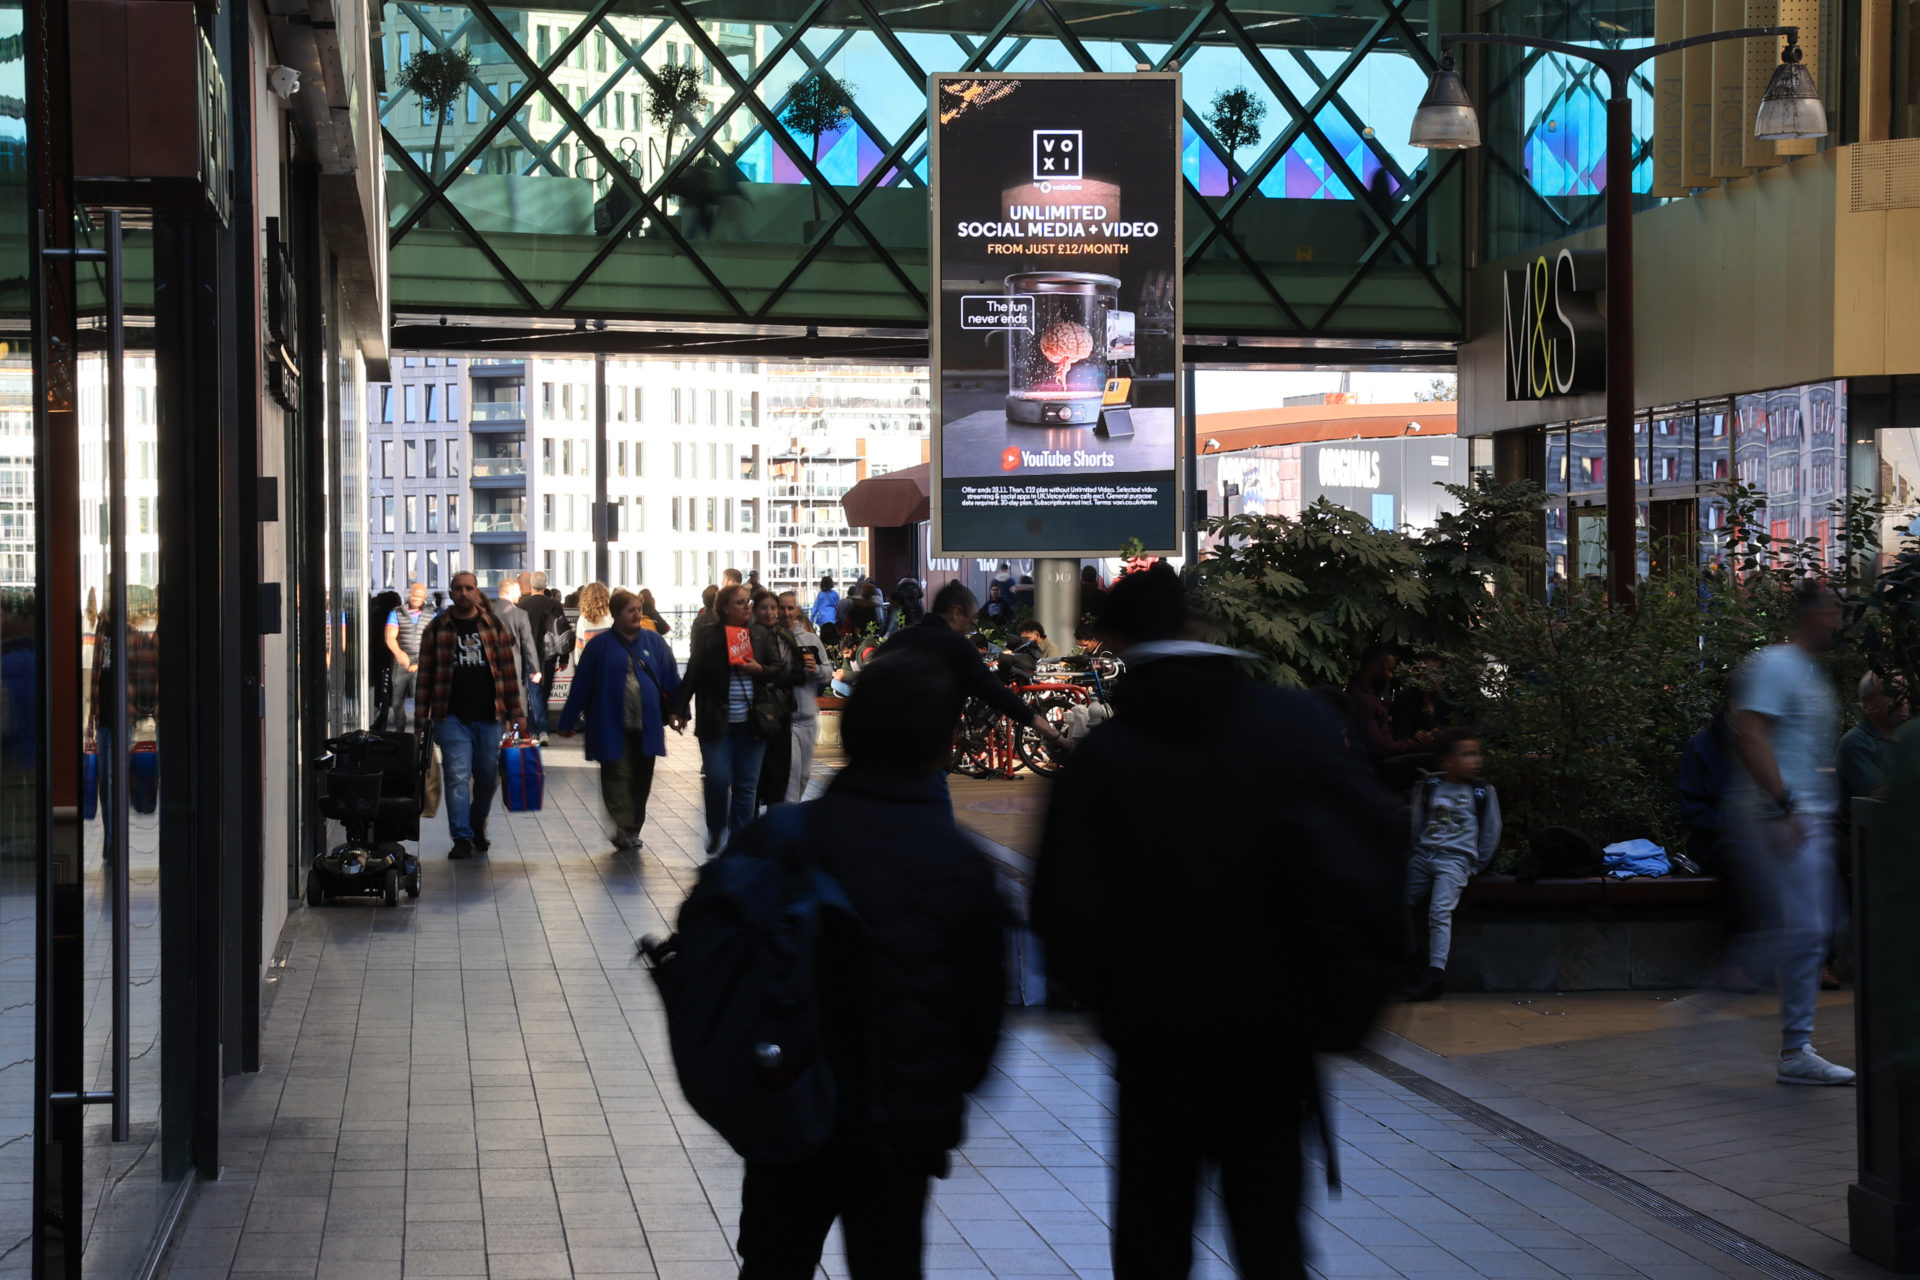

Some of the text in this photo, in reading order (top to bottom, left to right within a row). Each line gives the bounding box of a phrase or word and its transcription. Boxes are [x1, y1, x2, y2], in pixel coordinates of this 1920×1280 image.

[1663, 78, 1682, 187] FASHION
[1721, 86, 1743, 167] HOME
[1691, 103, 1711, 177] FOOD
[1009, 205, 1107, 220] UNLIMITED
[957, 221, 1159, 238] SOCIAL MEDIA + VIDEO
[987, 243, 1129, 255] FROM JUST £12/MONTH
[986, 300, 1028, 312] The fun
[967, 313, 1028, 324] never ends
[1503, 248, 1576, 401] M&S
[1021, 450, 1115, 467] YouTube Shorts
[1318, 447, 1380, 489] ORIGINALS
[961, 486, 977, 494] Offer
[977, 486, 991, 494] ends
[1036, 486, 1048, 494] plan
[1049, 486, 1069, 494] without
[1070, 486, 1097, 494] Unlimited
[1098, 486, 1115, 494] Video.
[1116, 486, 1140, 494] Selected
[1141, 486, 1157, 494] video
